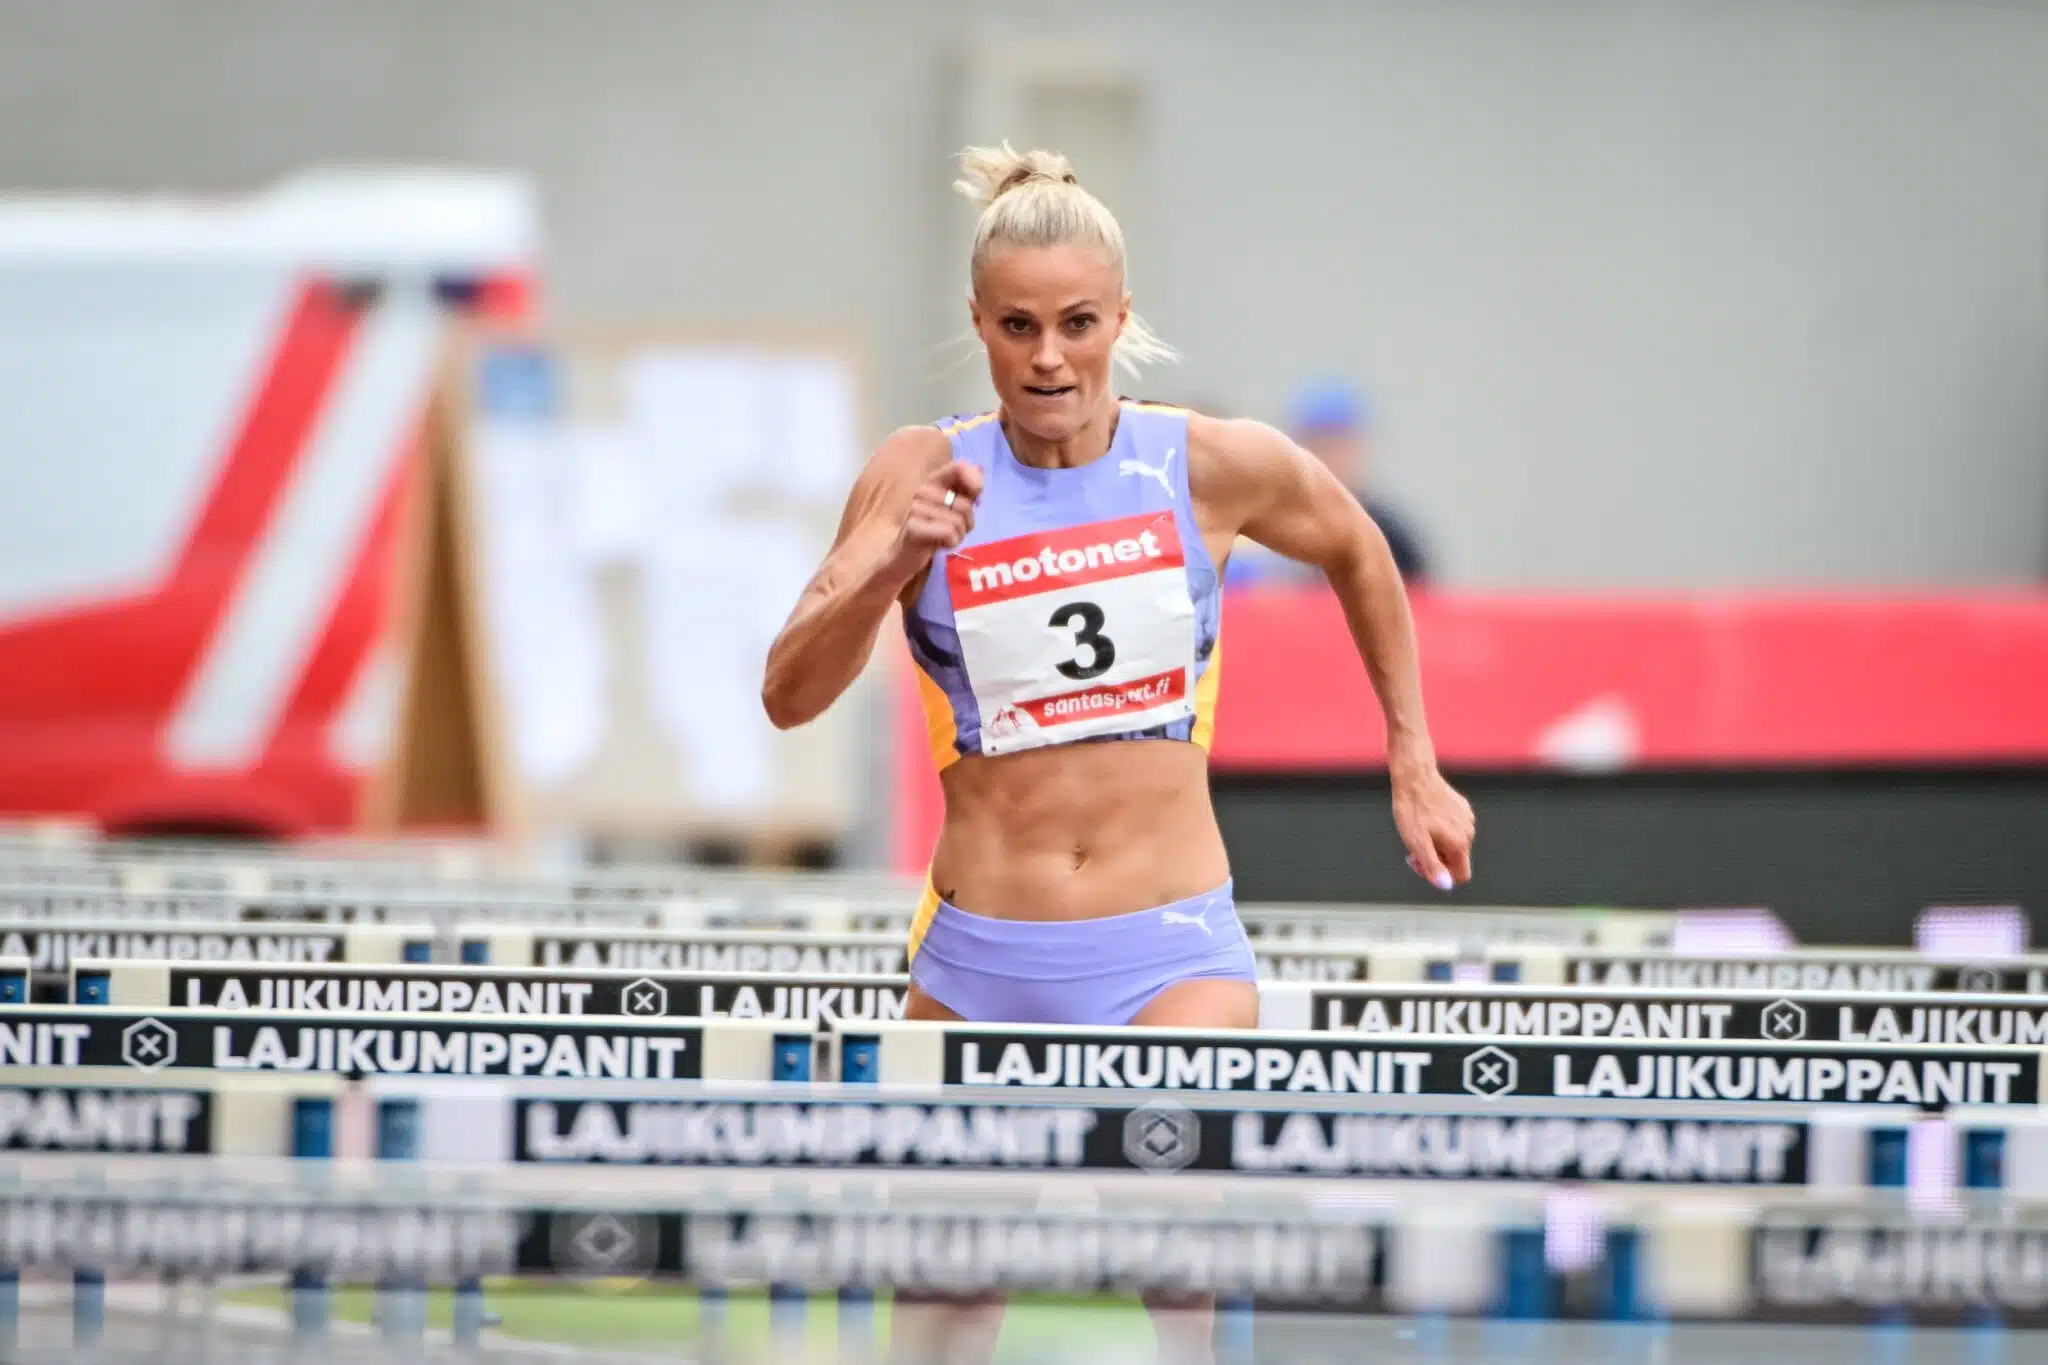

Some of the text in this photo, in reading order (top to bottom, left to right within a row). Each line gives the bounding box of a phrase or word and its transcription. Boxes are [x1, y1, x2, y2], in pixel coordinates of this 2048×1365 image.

[969, 529, 1161, 592] motonet
[1048, 601, 1115, 680] 3
[187, 978, 592, 1017] LAJIKUMPPANIT
[1328, 1000, 1732, 1039] LAJIKUMPPANIT
[213, 1026, 686, 1079] LAJIKUMPPANIT
[961, 1042, 2021, 1105] LAJIKUMPPANIT LAJIKUMPPANIT
